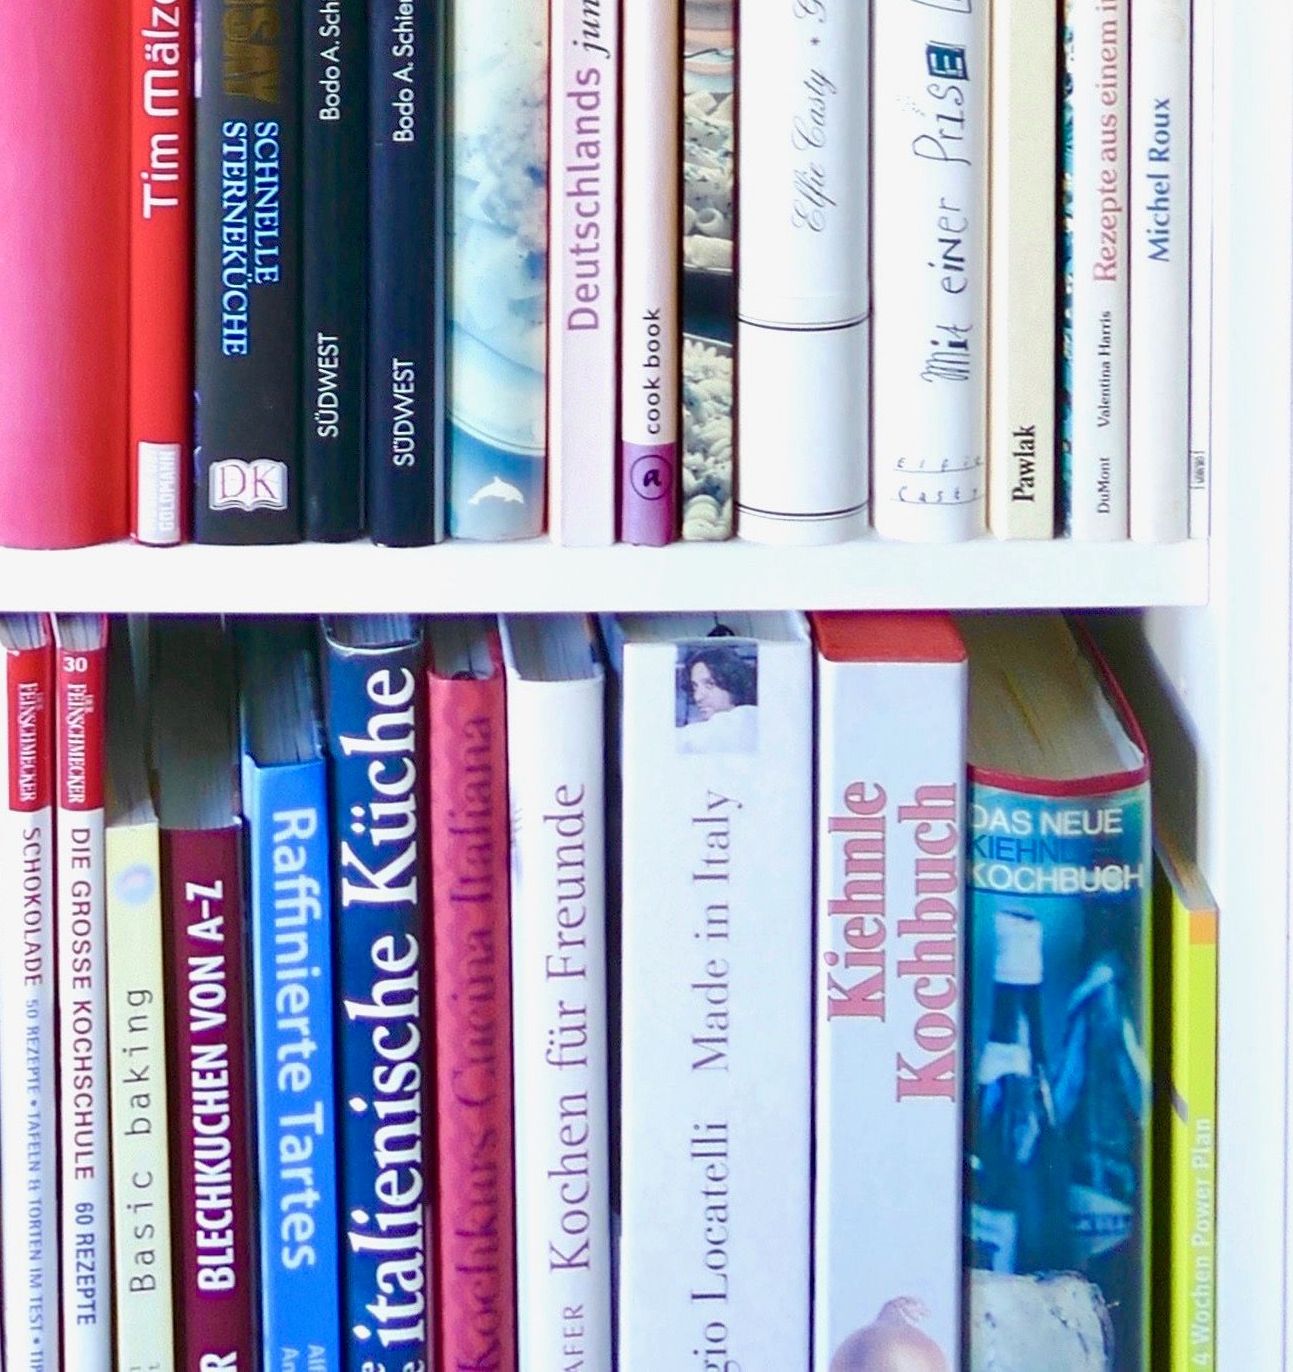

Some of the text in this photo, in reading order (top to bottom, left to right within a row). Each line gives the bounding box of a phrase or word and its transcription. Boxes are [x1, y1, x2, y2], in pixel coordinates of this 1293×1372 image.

[320, 41, 339, 62] A.
[320, 65, 339, 119] Bodo
[137, 126, 181, 225] Tim
[566, 68, 600, 330] Deutschlands
[1147, 100, 1169, 261] Michel Roux
[315, 333, 338, 437] SÜDWEST
[644, 310, 660, 367] book
[644, 378, 660, 434] cook
[1013, 426, 1034, 501] Pawlak
[1098, 458, 1109, 513] DuMont
[826, 784, 885, 1022] Kiehnle
[895, 785, 959, 1103] Kochbuch
[73, 829, 94, 1179] DIE GROSSE KOCHSCHULE
[189, 954, 228, 1031] VON
[340, 669, 423, 1351] italienische Küche
[544, 785, 590, 1269] Kochen für Freunde
[689, 789, 743, 1300] Locatelli Made in Italy
[123, 990, 156, 1292] Basic baking
[190, 1043, 234, 1289] BLECHKUCHEN
